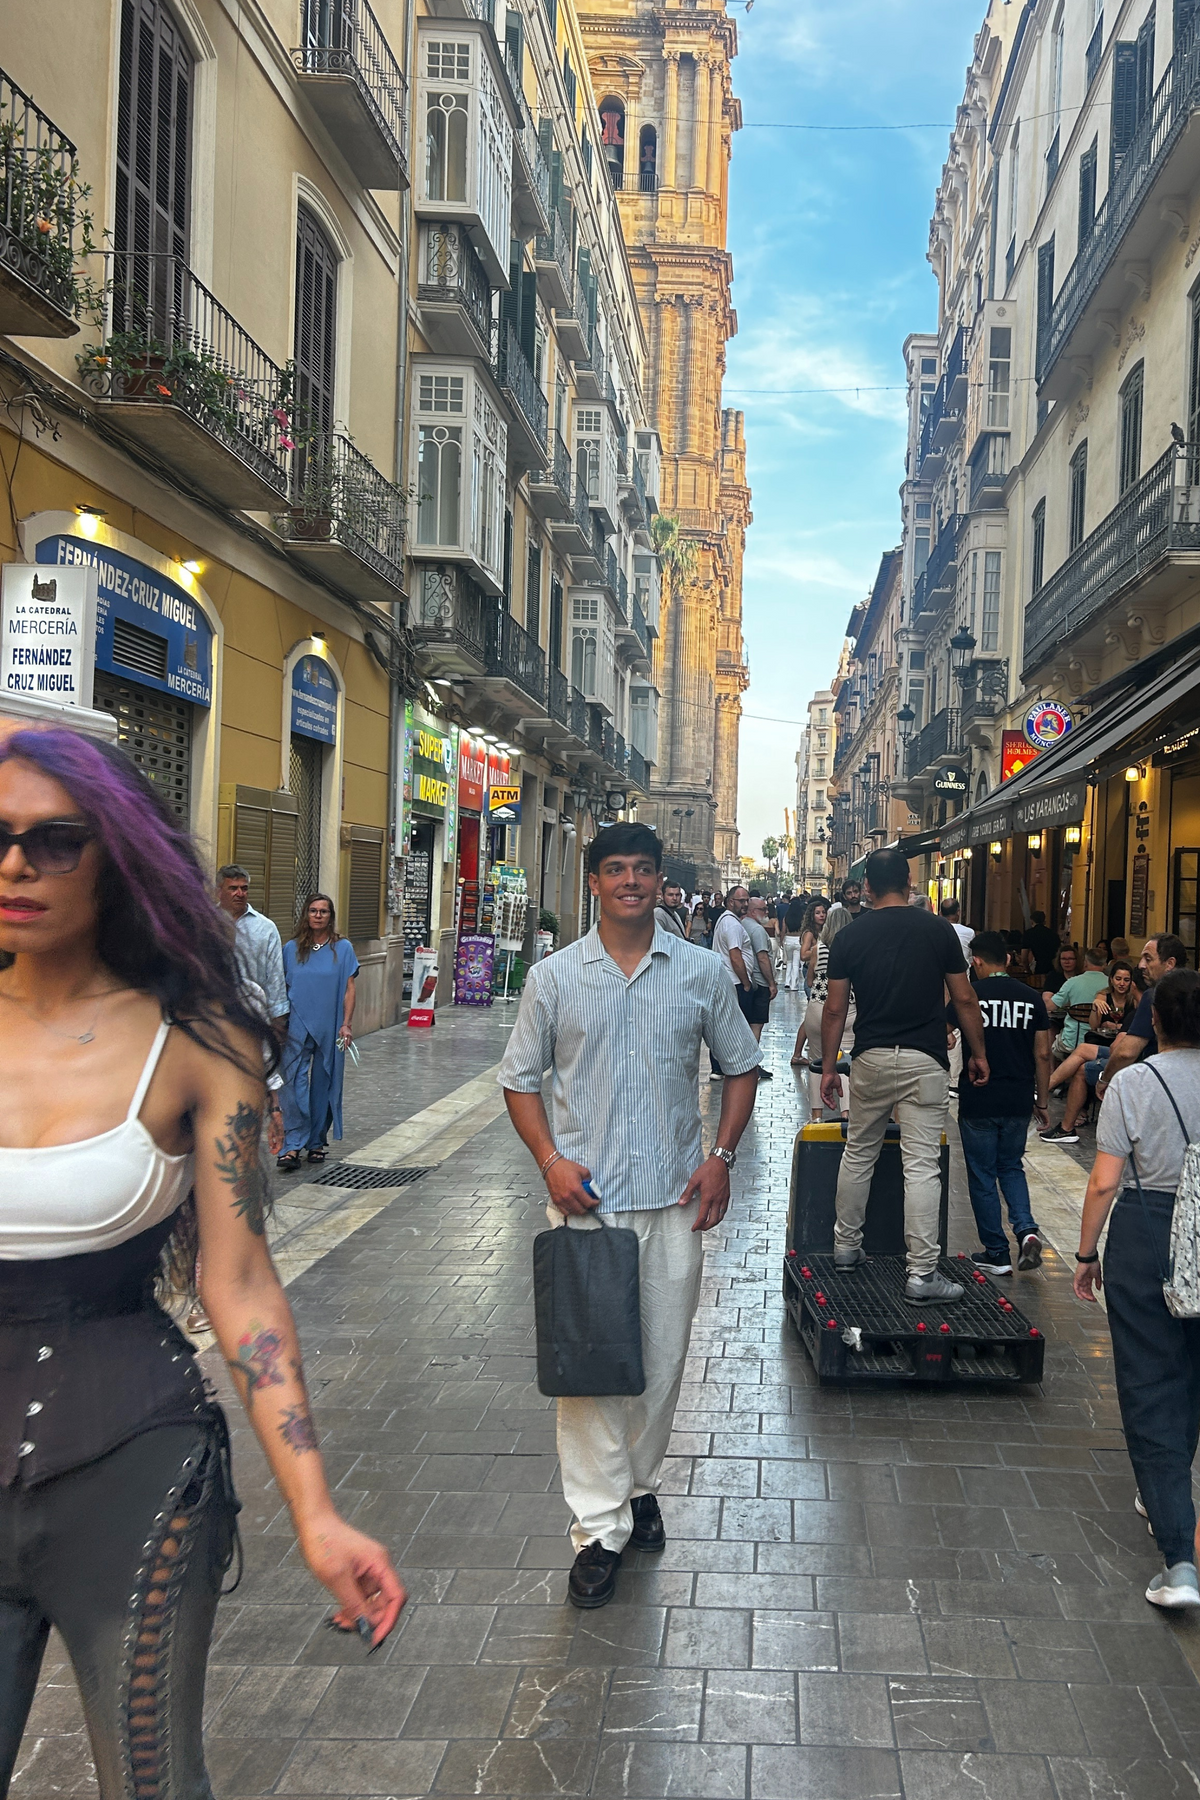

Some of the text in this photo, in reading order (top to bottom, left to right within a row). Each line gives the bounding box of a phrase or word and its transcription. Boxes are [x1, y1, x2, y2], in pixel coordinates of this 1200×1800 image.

[16, 606, 72, 615] LA CATEDRAL
[162, 592, 197, 631] MIGUEL
[9, 618, 77, 635] MERCERÍA
[12, 644, 72, 666] FERNÁNDEZ
[7, 673, 75, 691] CRUZ MIGUEL
[178, 665, 202, 681] LA CATEDRAL
[168, 673, 211, 702] MERCERÍA
[1028, 703, 1071, 722] PAULANER
[418, 729, 443, 764] SUPER
[461, 755, 485, 785] MARKET
[419, 774, 449, 807] MARKET
[491, 790, 518, 800] ATM
[935, 780, 966, 790] GUINNESS
[978, 999, 1035, 1030] STAFF
